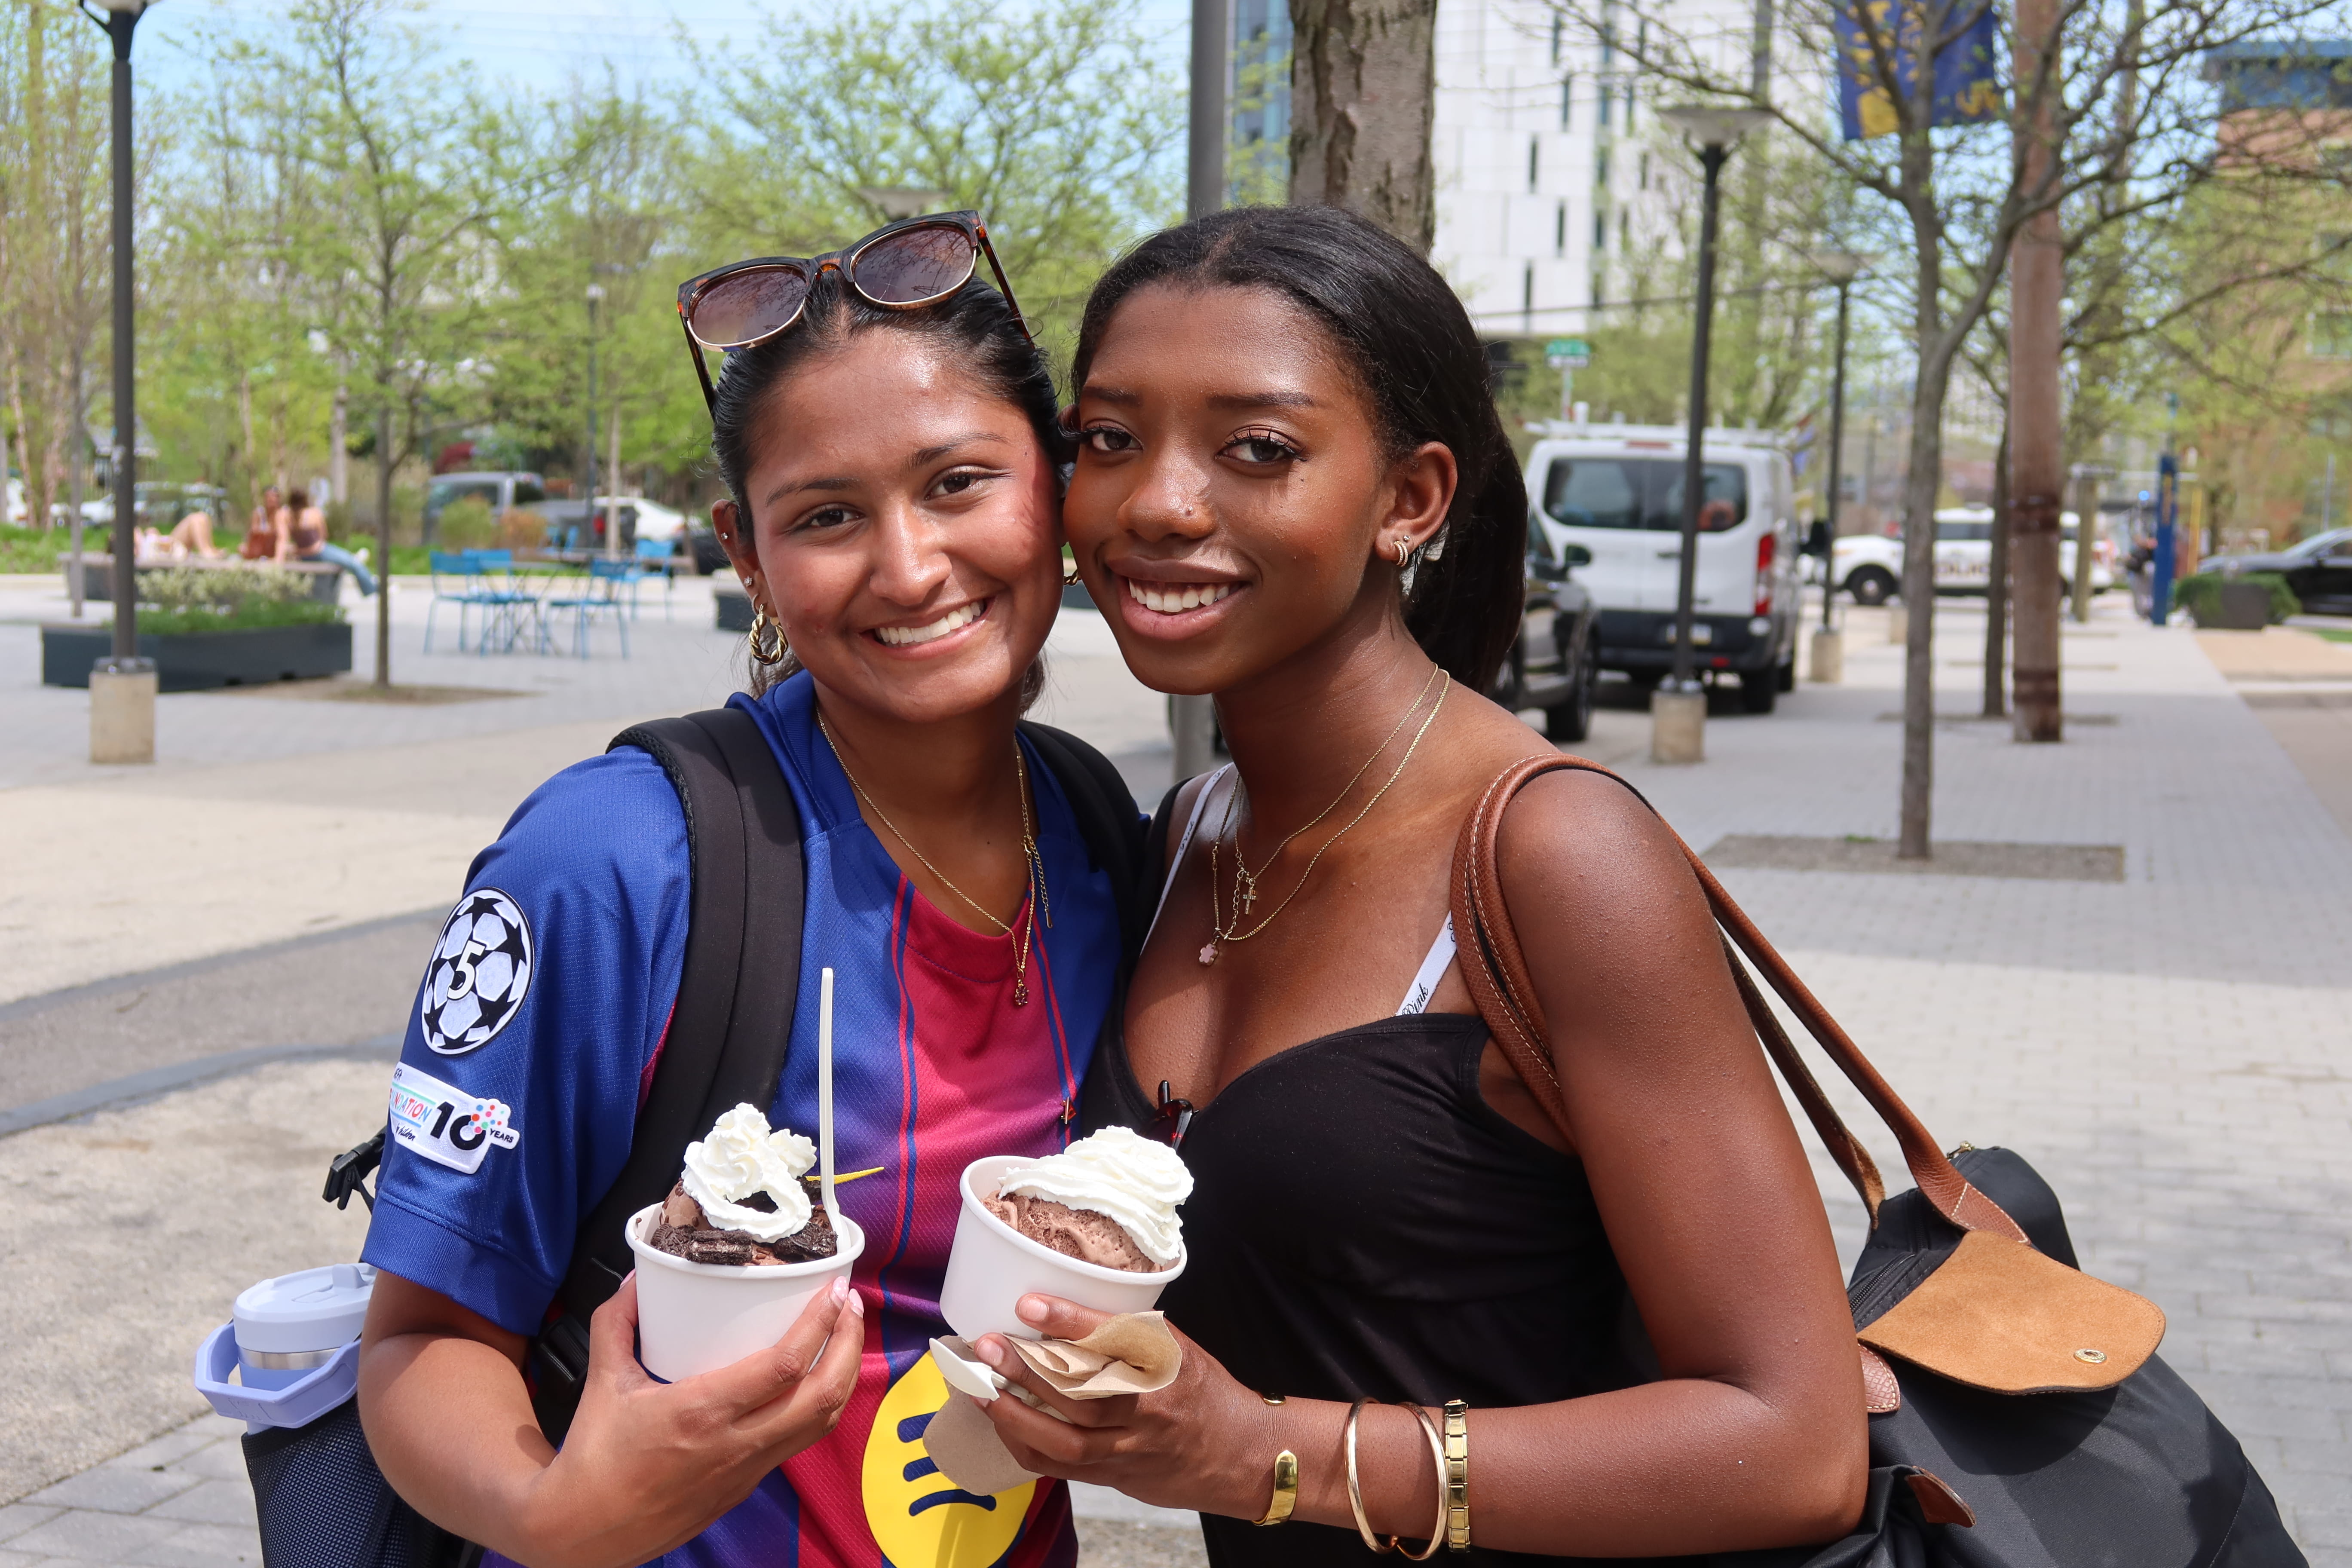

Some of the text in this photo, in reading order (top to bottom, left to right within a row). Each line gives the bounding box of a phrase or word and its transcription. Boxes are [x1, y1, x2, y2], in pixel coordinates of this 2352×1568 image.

[447, 939, 486, 1000] 5
[430, 1101, 486, 1151] 10
[490, 1128, 514, 1143] YEARS
